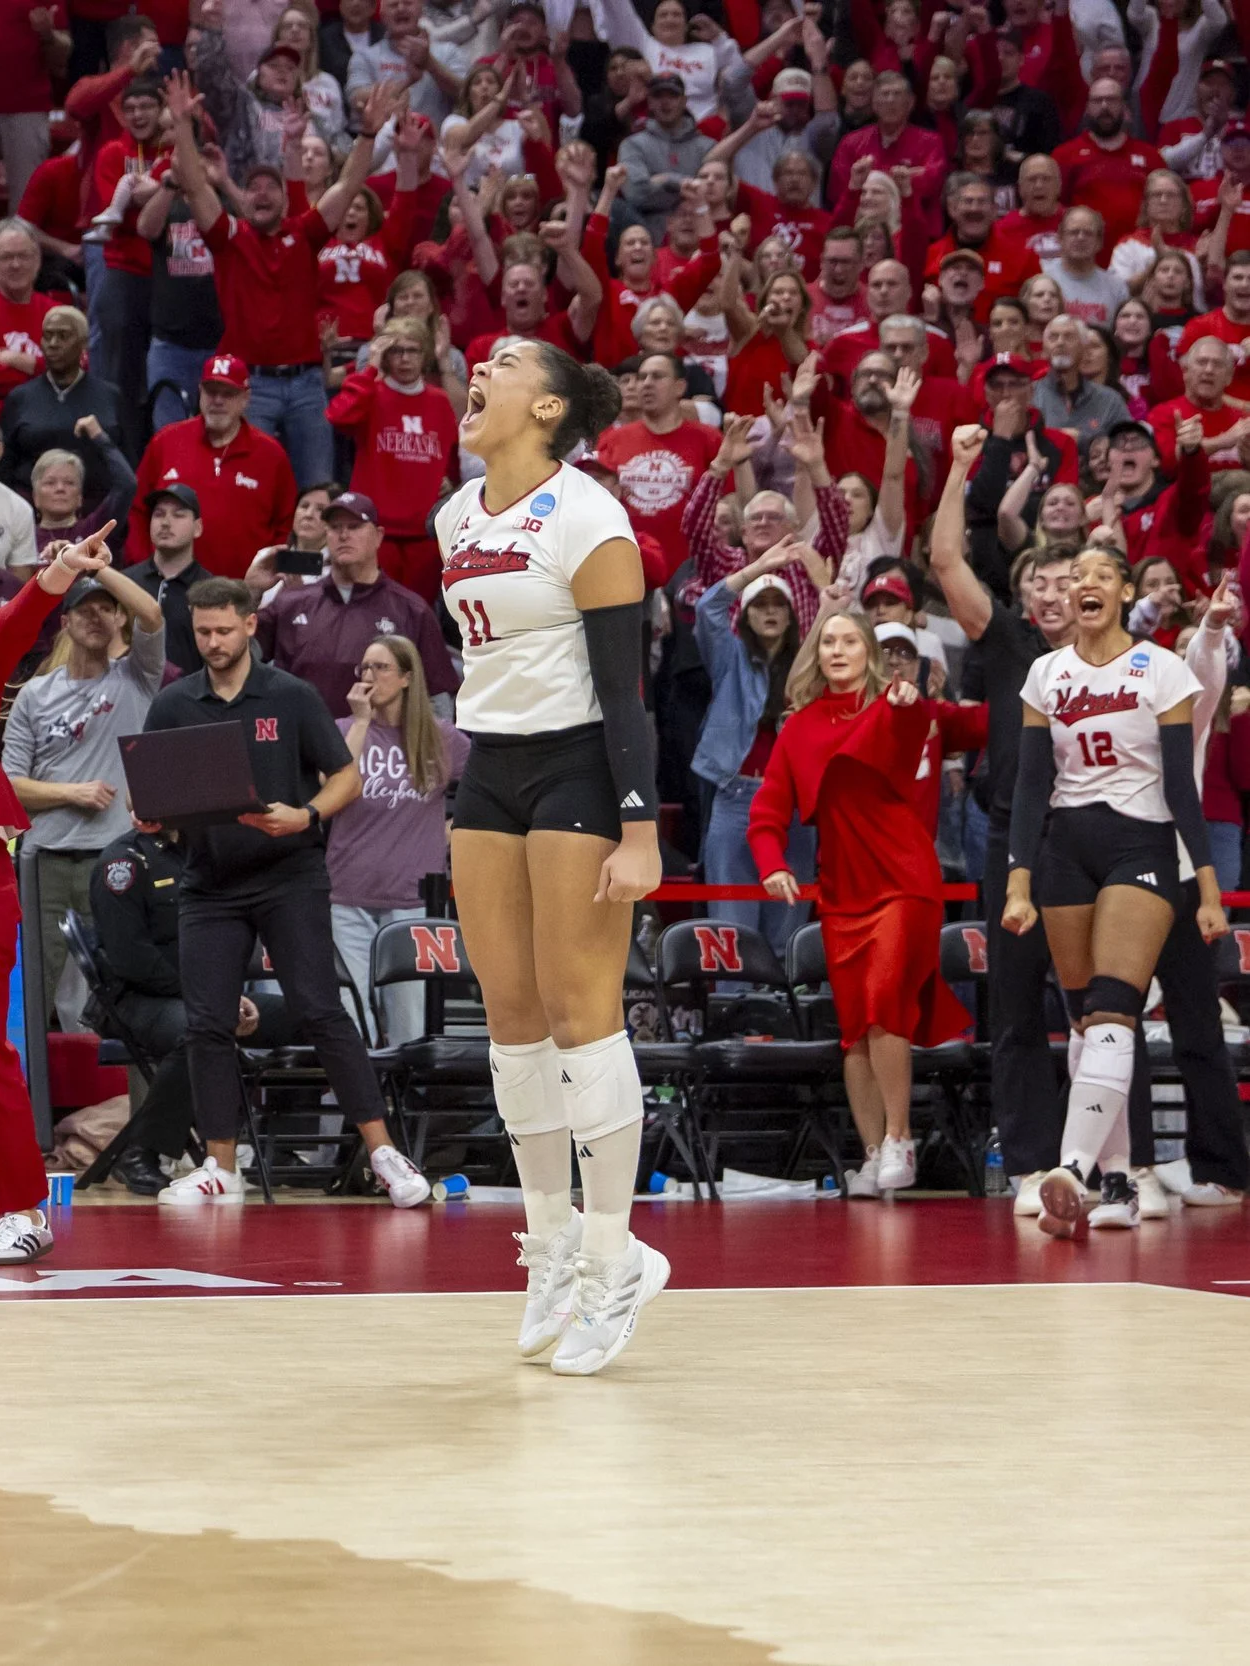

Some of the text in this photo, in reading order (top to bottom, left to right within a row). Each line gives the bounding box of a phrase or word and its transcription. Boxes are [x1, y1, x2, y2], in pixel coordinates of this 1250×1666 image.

[334, 257, 361, 283] N
[212, 359, 231, 375] N
[401, 414, 423, 434] N
[458, 599, 501, 646] 11
[255, 717, 279, 742] N
[1077, 731, 1118, 767] 12
[410, 926, 461, 973] N
[693, 926, 744, 973] N
